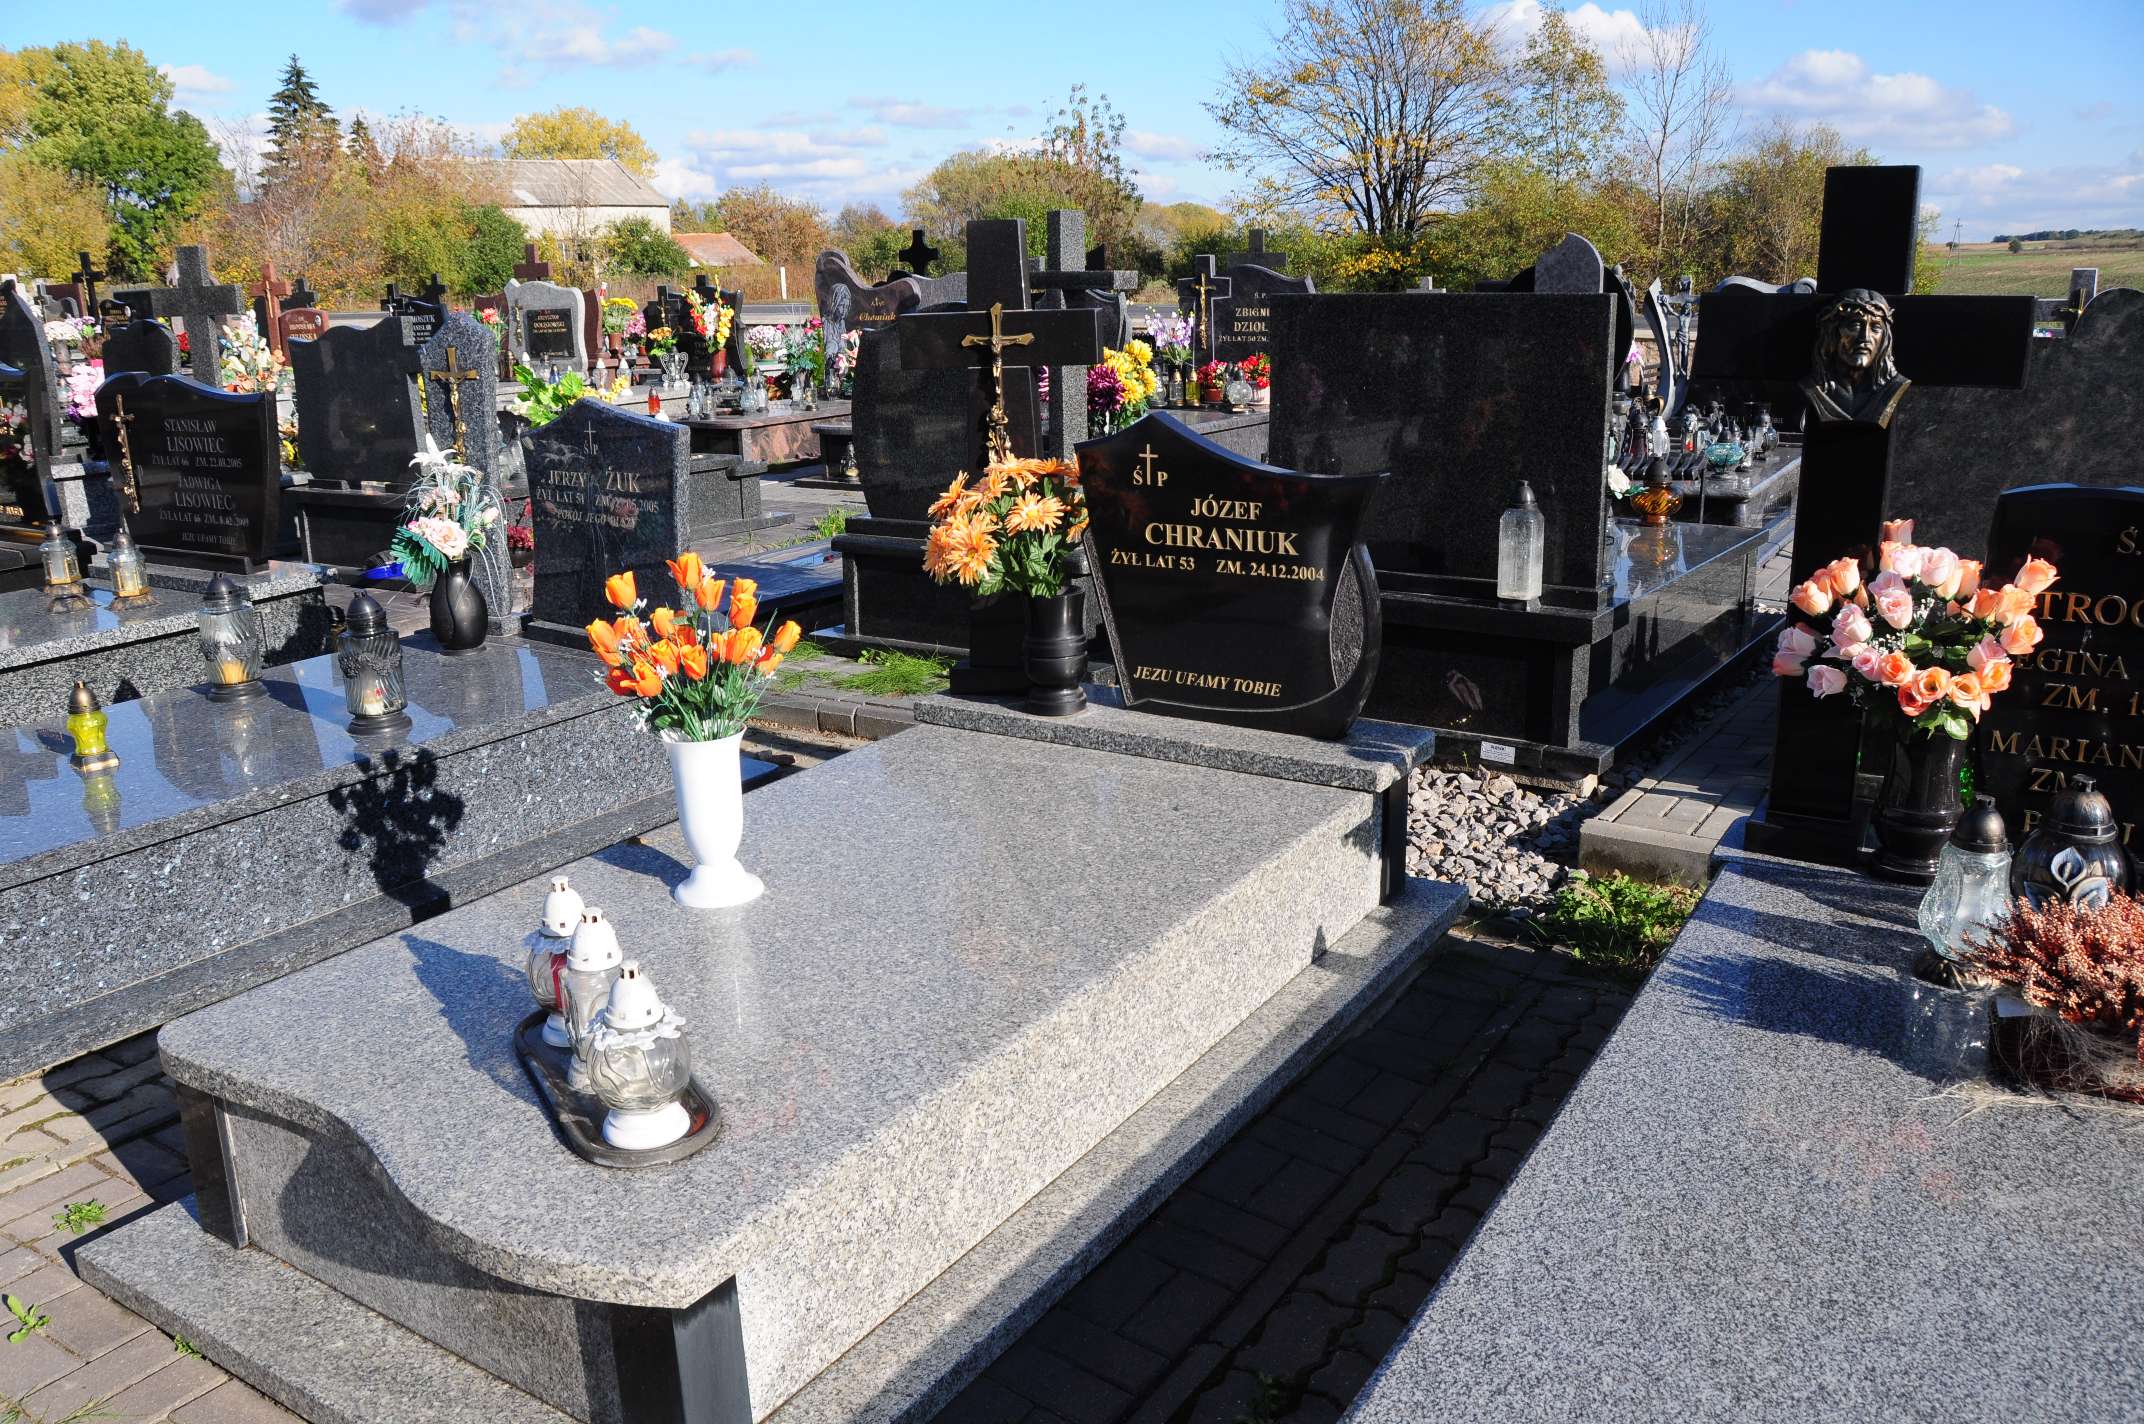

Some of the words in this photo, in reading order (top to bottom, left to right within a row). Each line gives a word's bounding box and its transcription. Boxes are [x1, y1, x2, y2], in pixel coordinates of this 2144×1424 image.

[166, 436, 225, 453] LISOWIEC
[178, 475, 223, 491] JADWIGA
[605, 466, 641, 493] ŻUK
[1133, 465, 1143, 486] Ś
[1157, 471, 1169, 487] P
[174, 491, 233, 511] LISOWIEC
[556, 491, 574, 503] LAT
[1190, 493, 1263, 520] JÓZEF
[1145, 522, 1299, 556] CHRANIUK
[1111, 547, 1142, 566] ŻYŁ
[1145, 553, 1176, 569] LAT
[1179, 556, 1195, 570] 53
[1216, 559, 1246, 575] ZM.
[1250, 562, 1325, 582] 24.12.2004
[1133, 665, 1172, 683] JEZU
[1175, 670, 1231, 690] UFAMY
[1232, 678, 1282, 697] TOBIE
[2041, 683, 2111, 714] ZM.
